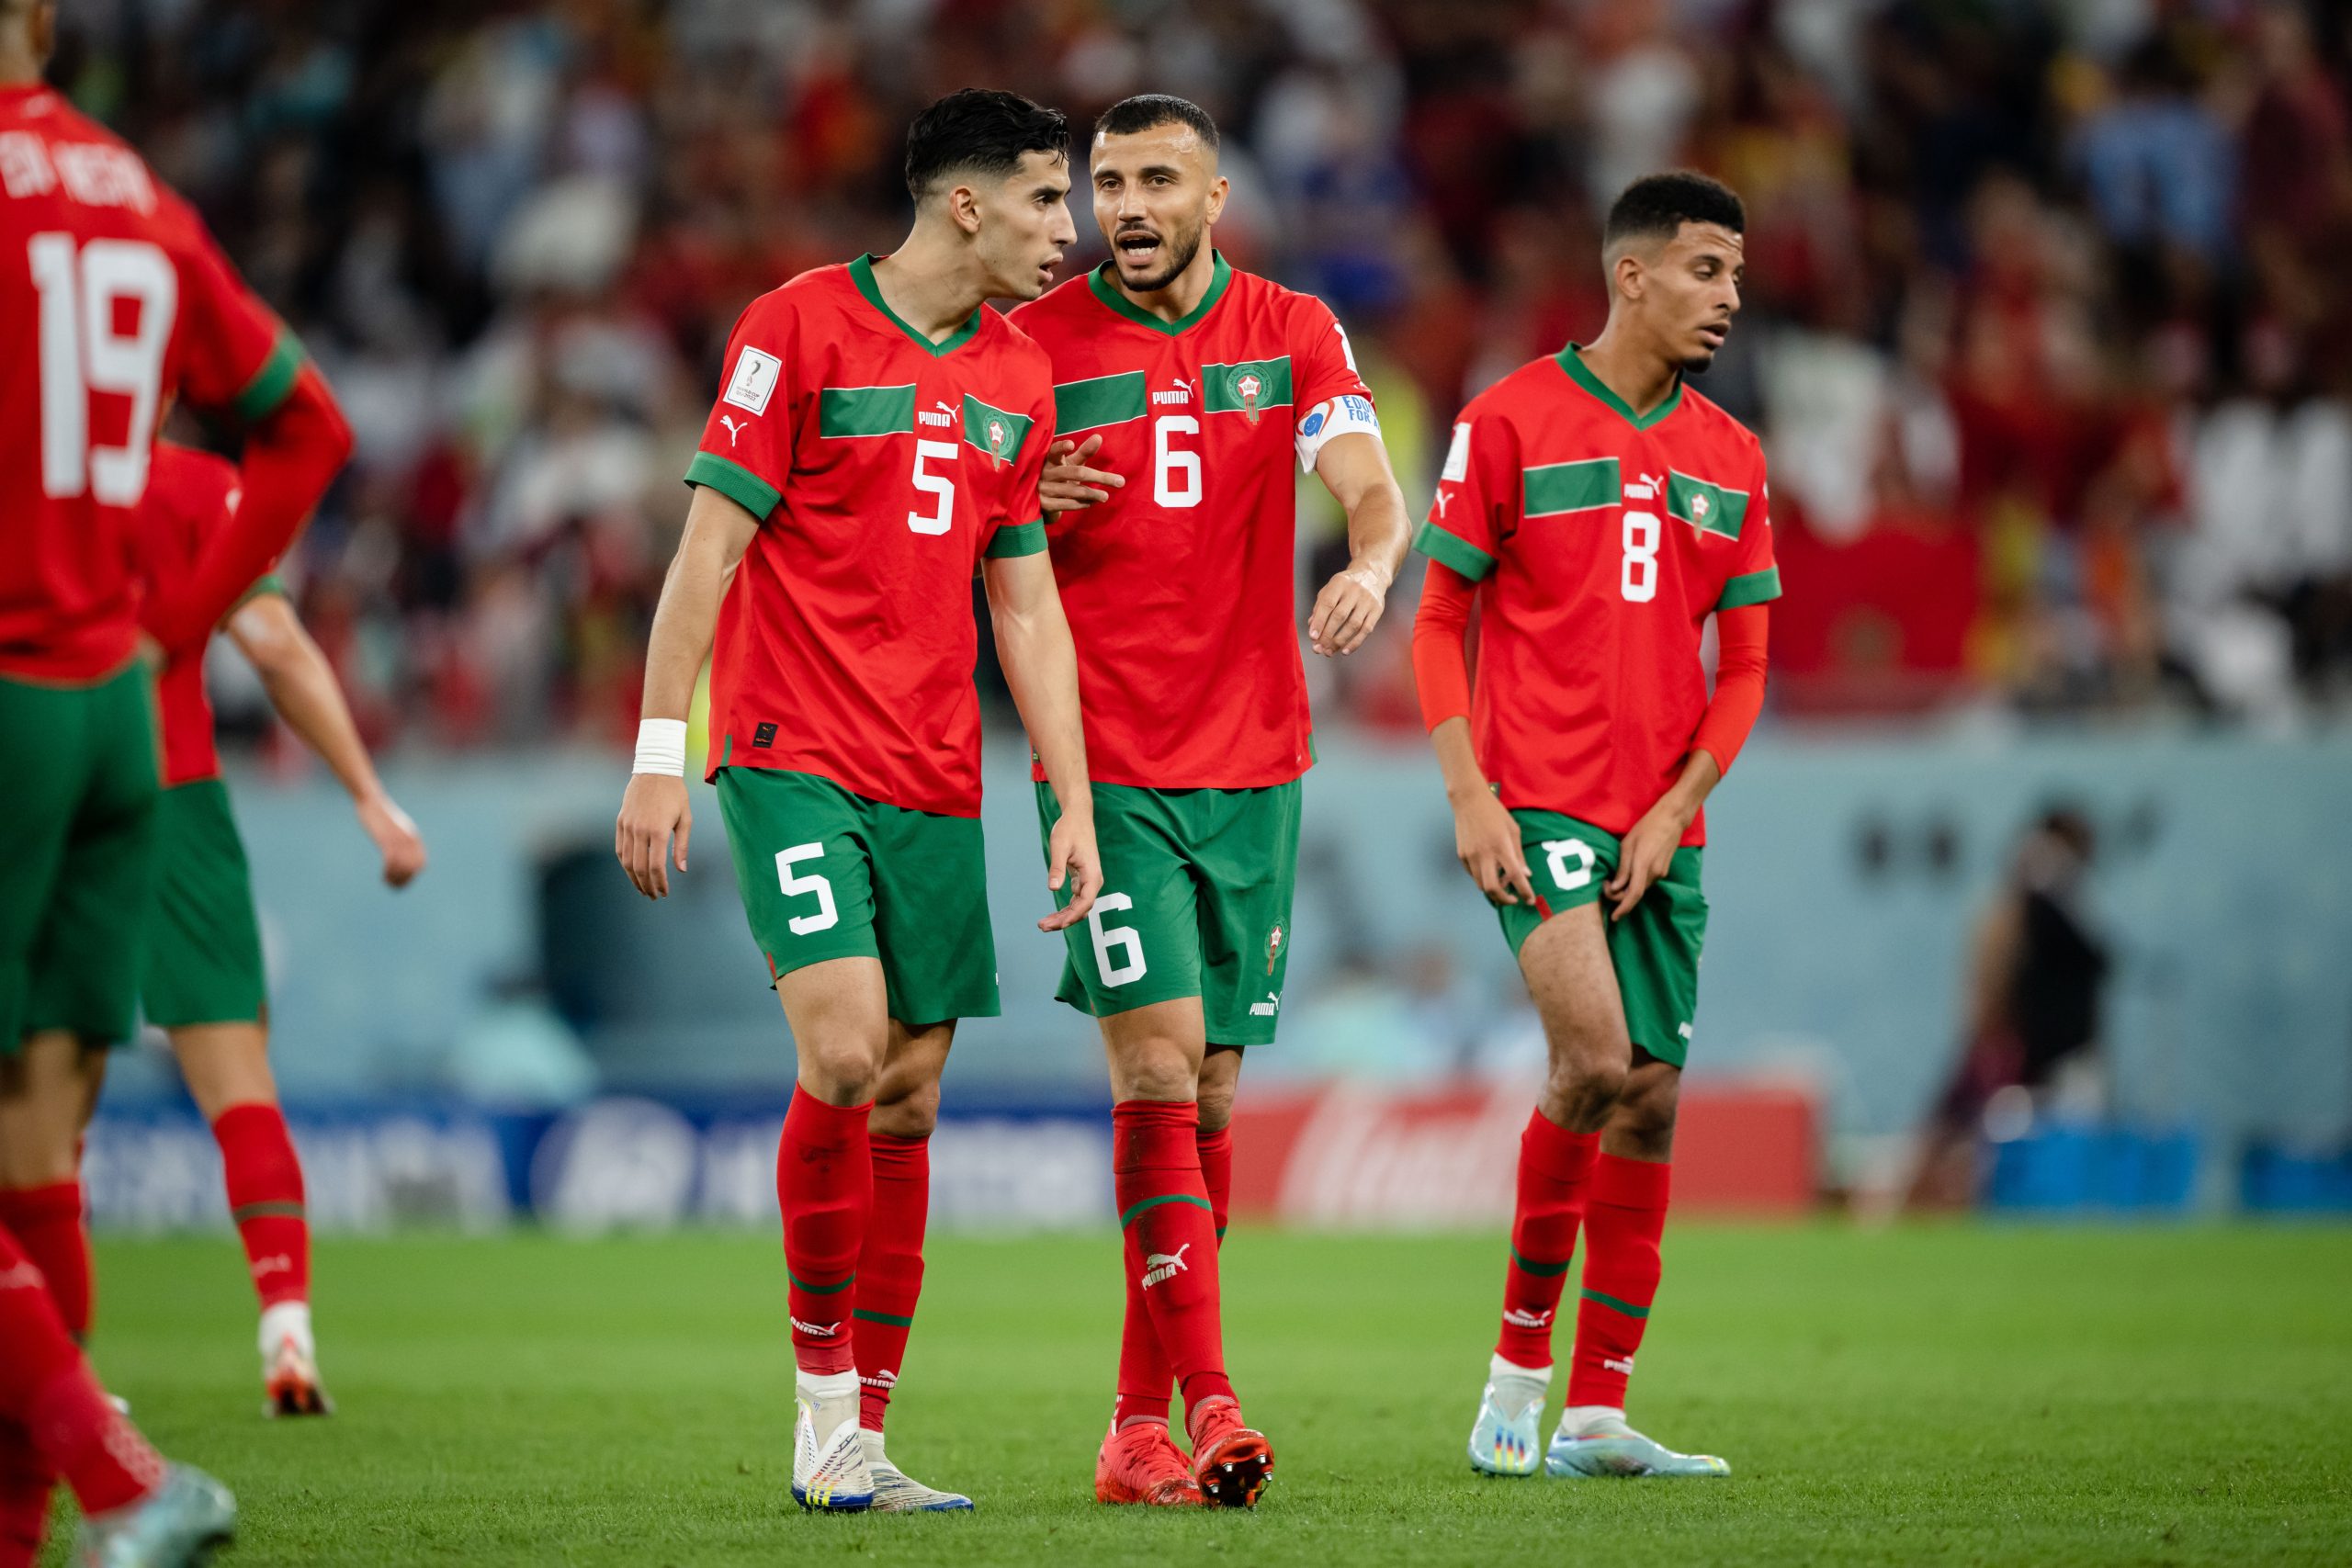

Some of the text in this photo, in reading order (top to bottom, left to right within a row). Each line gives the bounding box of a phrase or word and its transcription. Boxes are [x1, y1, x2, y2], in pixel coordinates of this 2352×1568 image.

[27, 230, 178, 509] 19
[1152, 390, 1189, 405] PUMA
[918, 411, 951, 428] PUMA
[1153, 415, 1203, 508] 6
[1348, 409, 1372, 423] FOR
[907, 439, 958, 536] 5
[1621, 511, 1661, 603] 8
[775, 841, 839, 936] 5
[1088, 892, 1148, 988] 6
[1249, 1002, 1275, 1016] PUMA
